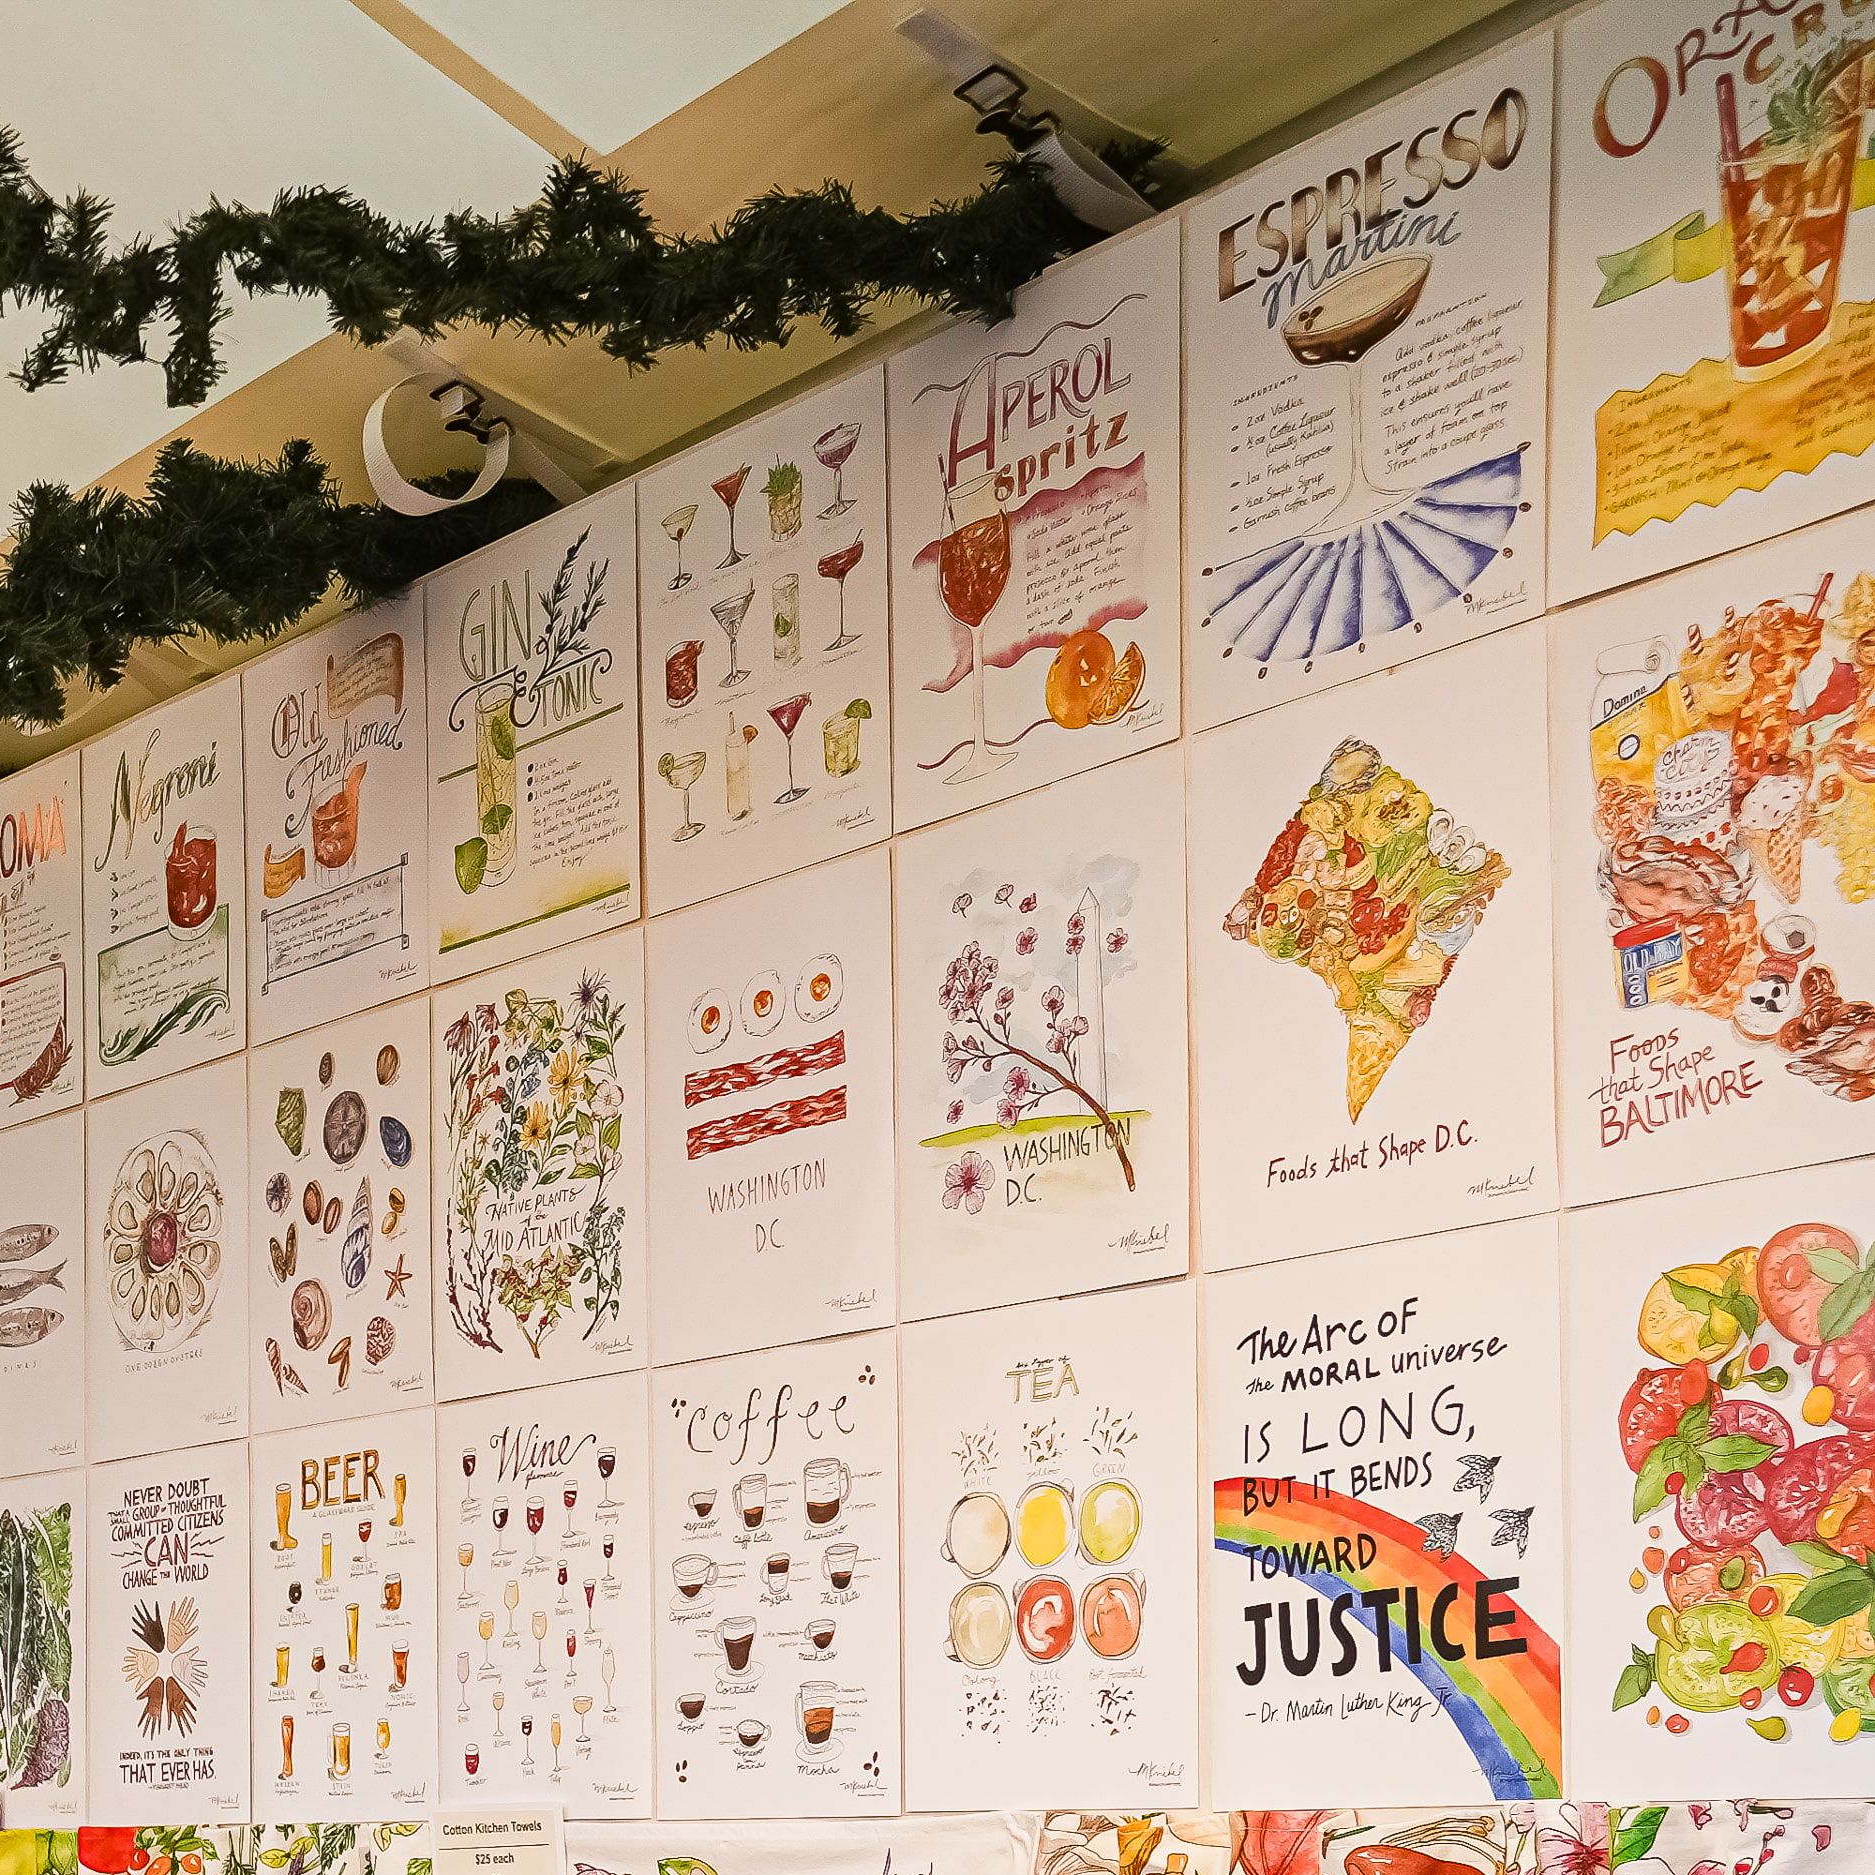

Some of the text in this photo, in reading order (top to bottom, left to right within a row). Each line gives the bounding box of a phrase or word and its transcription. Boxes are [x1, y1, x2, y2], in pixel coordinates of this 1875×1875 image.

[1218, 87, 1528, 302] ESPRESSO
[1261, 210, 1462, 328] martini
[950, 337, 1133, 487] APEROL
[459, 569, 532, 684] GIN
[271, 680, 323, 758] Old
[535, 668, 605, 726] TONIC
[1602, 684, 1648, 715] Domino
[94, 728, 222, 871] Negroni
[285, 707, 409, 837] Fashioned
[1589, 1041, 1716, 1103] that Shape
[1599, 1061, 1764, 1148] BALTIMORE
[1004, 1117, 1132, 1171] WASHINGTON
[1266, 1121, 1478, 1187] Foods that Shape D.C.
[486, 1199, 532, 1221] NATIVE
[708, 1159, 827, 1215] WASHINGTON
[1006, 1178, 1042, 1207] D.C.
[484, 1211, 587, 1256] MID ATLANTIC
[1237, 1314, 1369, 1366] The Arc
[1281, 1334, 1508, 1393] MORAL universe
[1005, 1363, 1080, 1403] TEA
[1242, 1384, 1476, 1464] IS LONG,
[301, 1448, 385, 1511] BEER
[489, 1424, 597, 1483] Wine
[124, 1478, 210, 1507] NEVER DOUBT
[133, 1495, 227, 1521] GROUP THOUGHTFUL
[1242, 1452, 1433, 1517] BUT IT BENDS
[112, 1509, 223, 1541] COMMITTED CITIZENS
[144, 1532, 188, 1567] CAN
[123, 1564, 209, 1589] CHANGE WORLD
[1242, 1532, 1378, 1583] TOWARD
[1235, 1575, 1528, 1688] JUSTICE
[1286, 1690, 1431, 1721] Martin Luther King
[119, 1762, 191, 1783] THAT EVER
[443, 1821, 542, 1835] Cotton Kitchen Towels
[475, 1853, 514, 1865] $25 each
